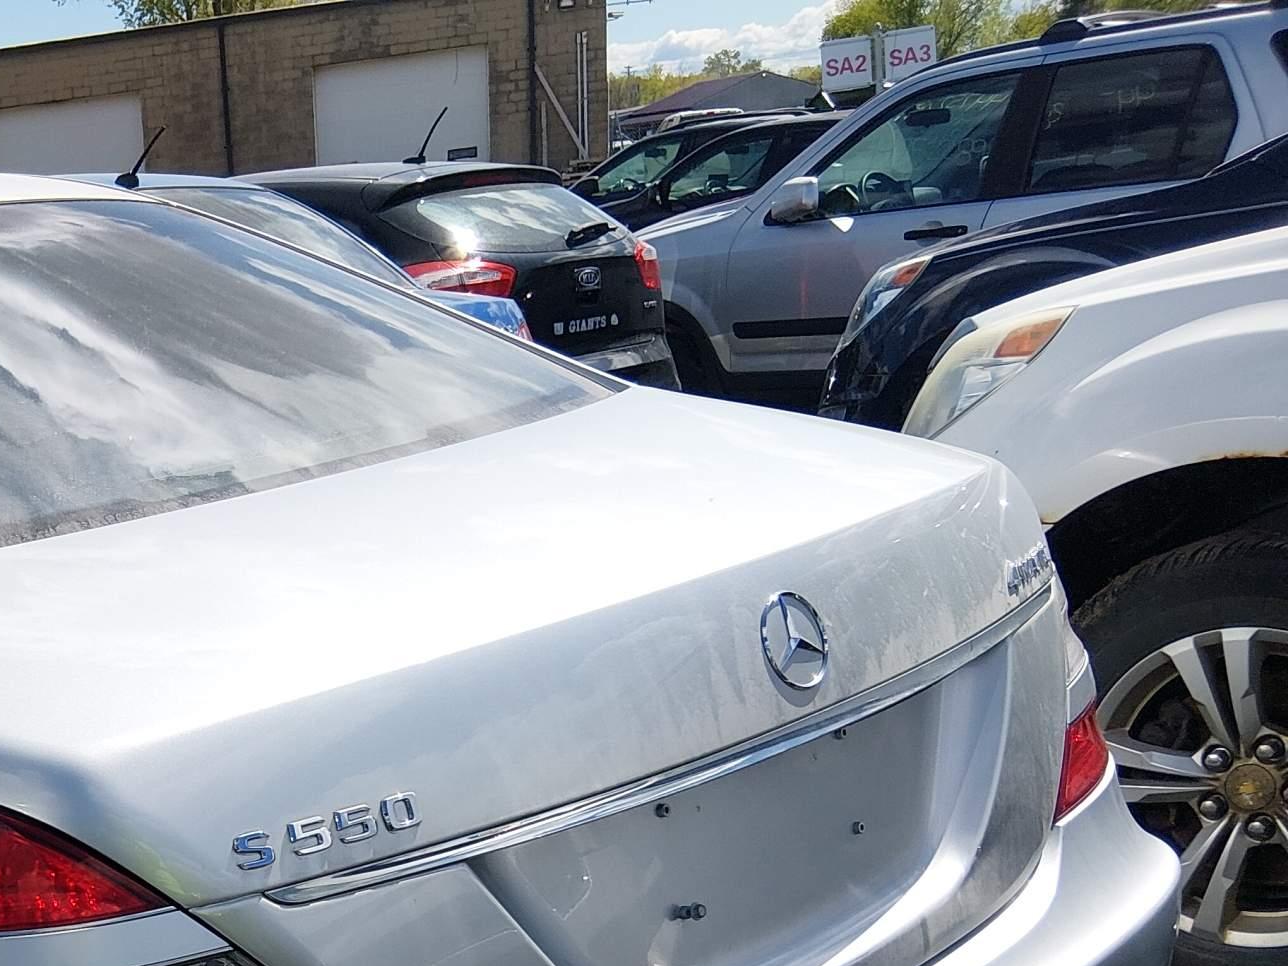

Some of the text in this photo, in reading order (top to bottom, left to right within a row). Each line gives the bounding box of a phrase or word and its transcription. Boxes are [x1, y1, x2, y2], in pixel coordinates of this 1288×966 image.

[825, 54, 867, 77] SA2
[888, 44, 932, 67] SA3
[568, 315, 607, 333] GIANTS
[232, 791, 423, 871] S 550
